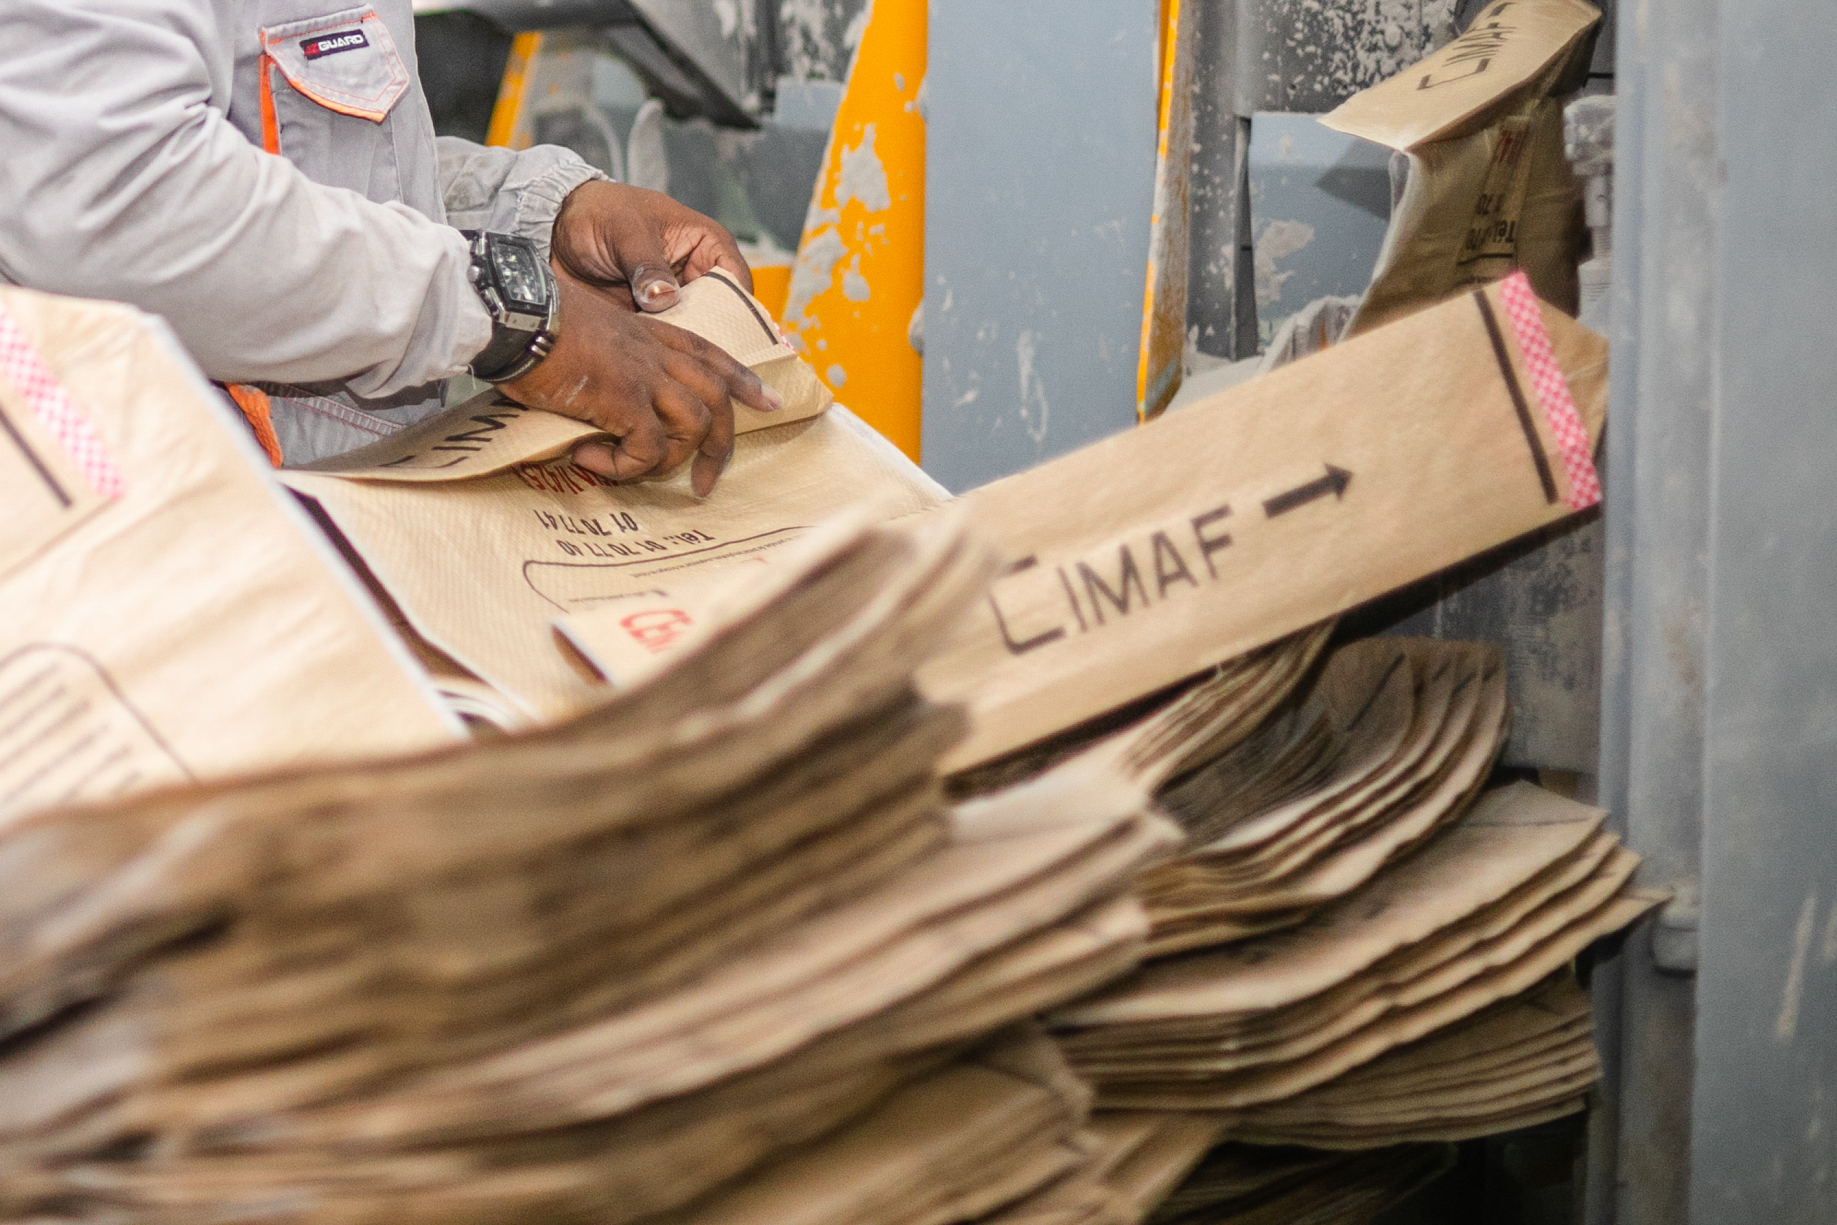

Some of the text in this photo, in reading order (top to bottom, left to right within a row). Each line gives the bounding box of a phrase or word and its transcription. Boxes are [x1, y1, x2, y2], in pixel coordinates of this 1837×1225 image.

[581, 518, 612, 536] 70
[610, 511, 639, 533] 01
[607, 542, 642, 556] 70
[986, 504, 1234, 655] CIMAF
